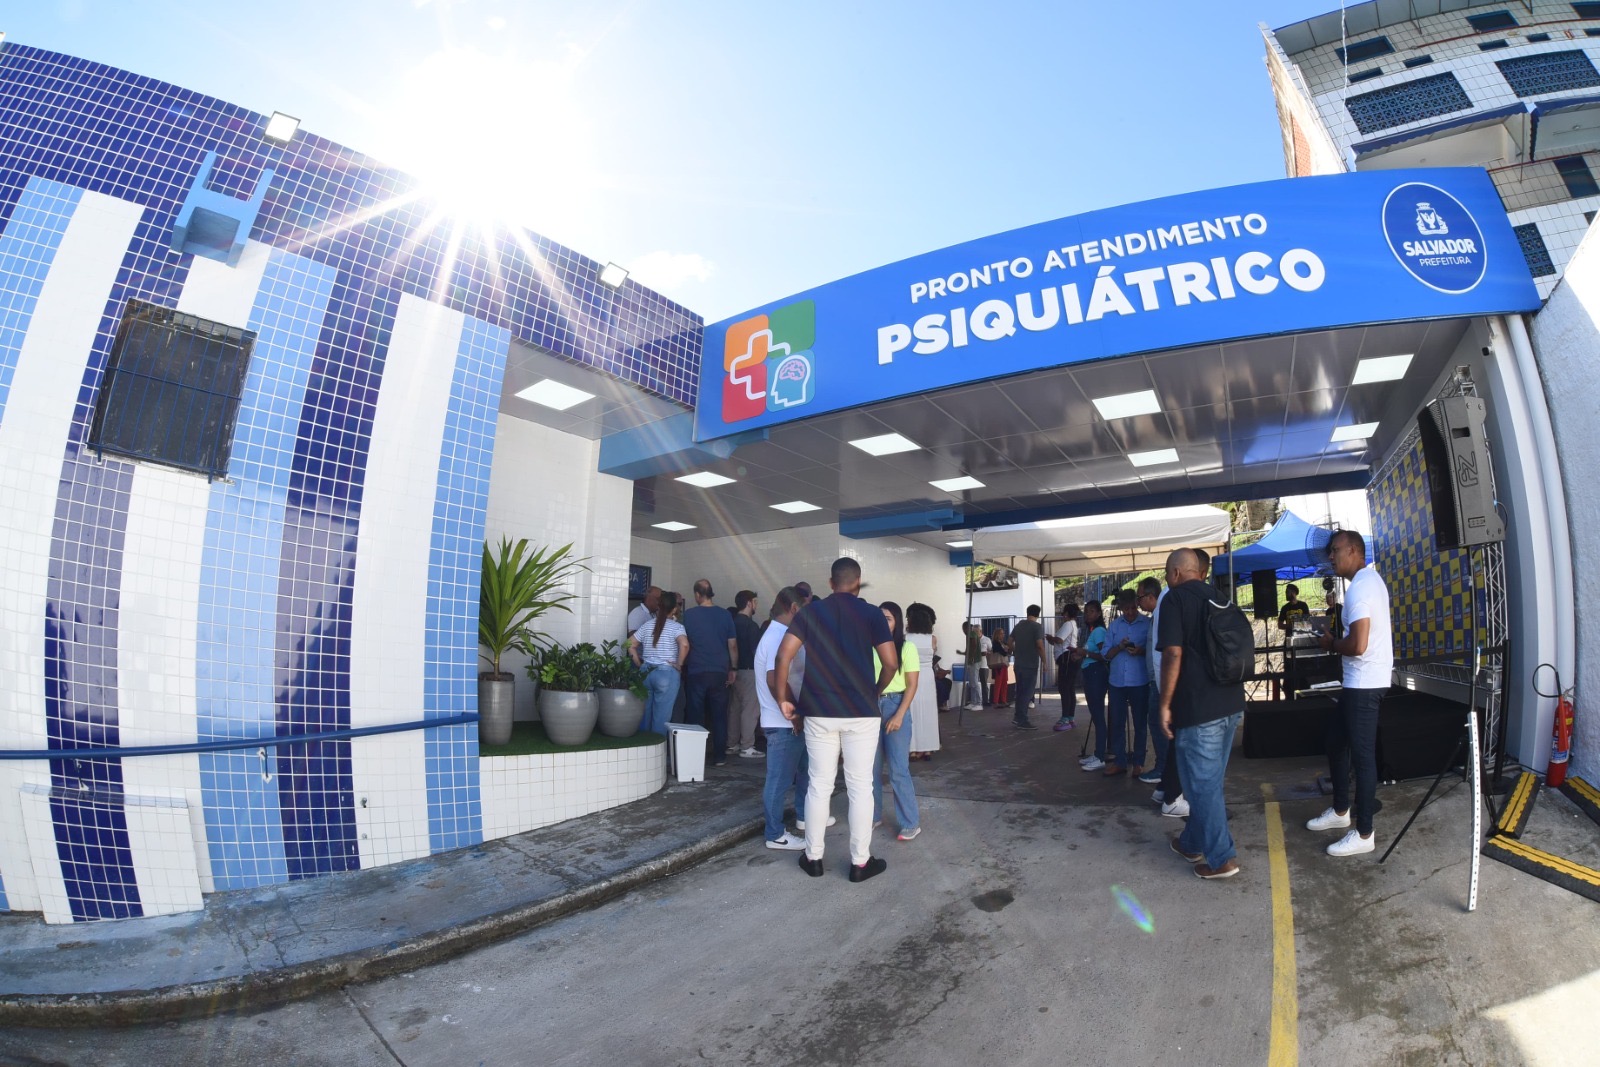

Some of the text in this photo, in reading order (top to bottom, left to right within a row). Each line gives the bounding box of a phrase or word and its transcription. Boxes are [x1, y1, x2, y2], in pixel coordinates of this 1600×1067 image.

[911, 213, 1268, 304] PRONTO ATENDIMENTO
[1402, 238, 1478, 257] SALVADOR
[1419, 256, 1472, 266] PREFEITURA
[877, 248, 1326, 365] PSIQUIÁTRICO
